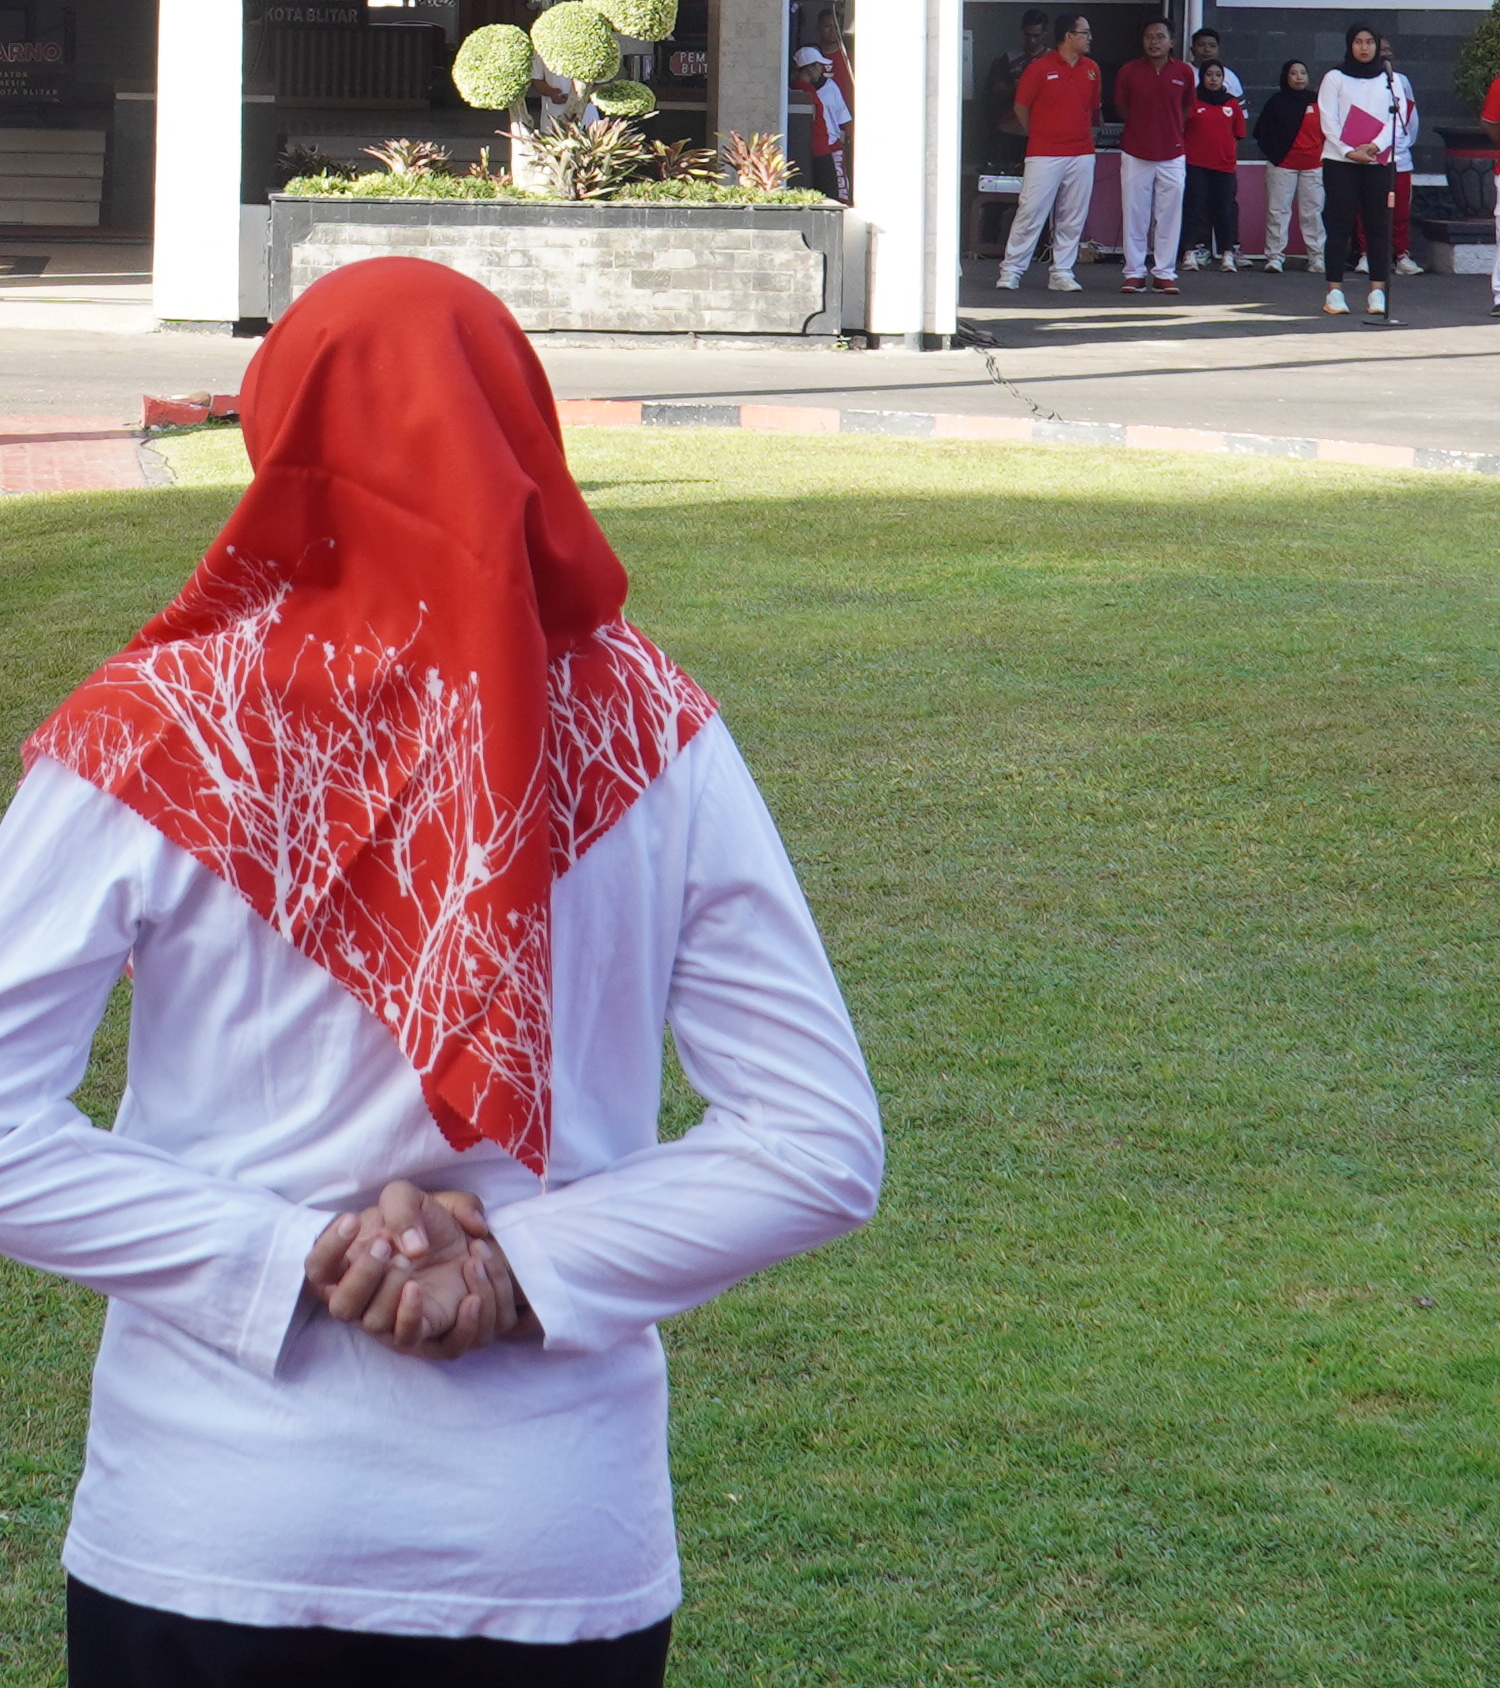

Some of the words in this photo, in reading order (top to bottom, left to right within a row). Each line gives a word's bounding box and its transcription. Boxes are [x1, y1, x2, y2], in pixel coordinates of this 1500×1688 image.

[266, 8, 304, 22] KOTA
[306, 9, 358, 23] BLITAR
[682, 63, 708, 74] BLIT
